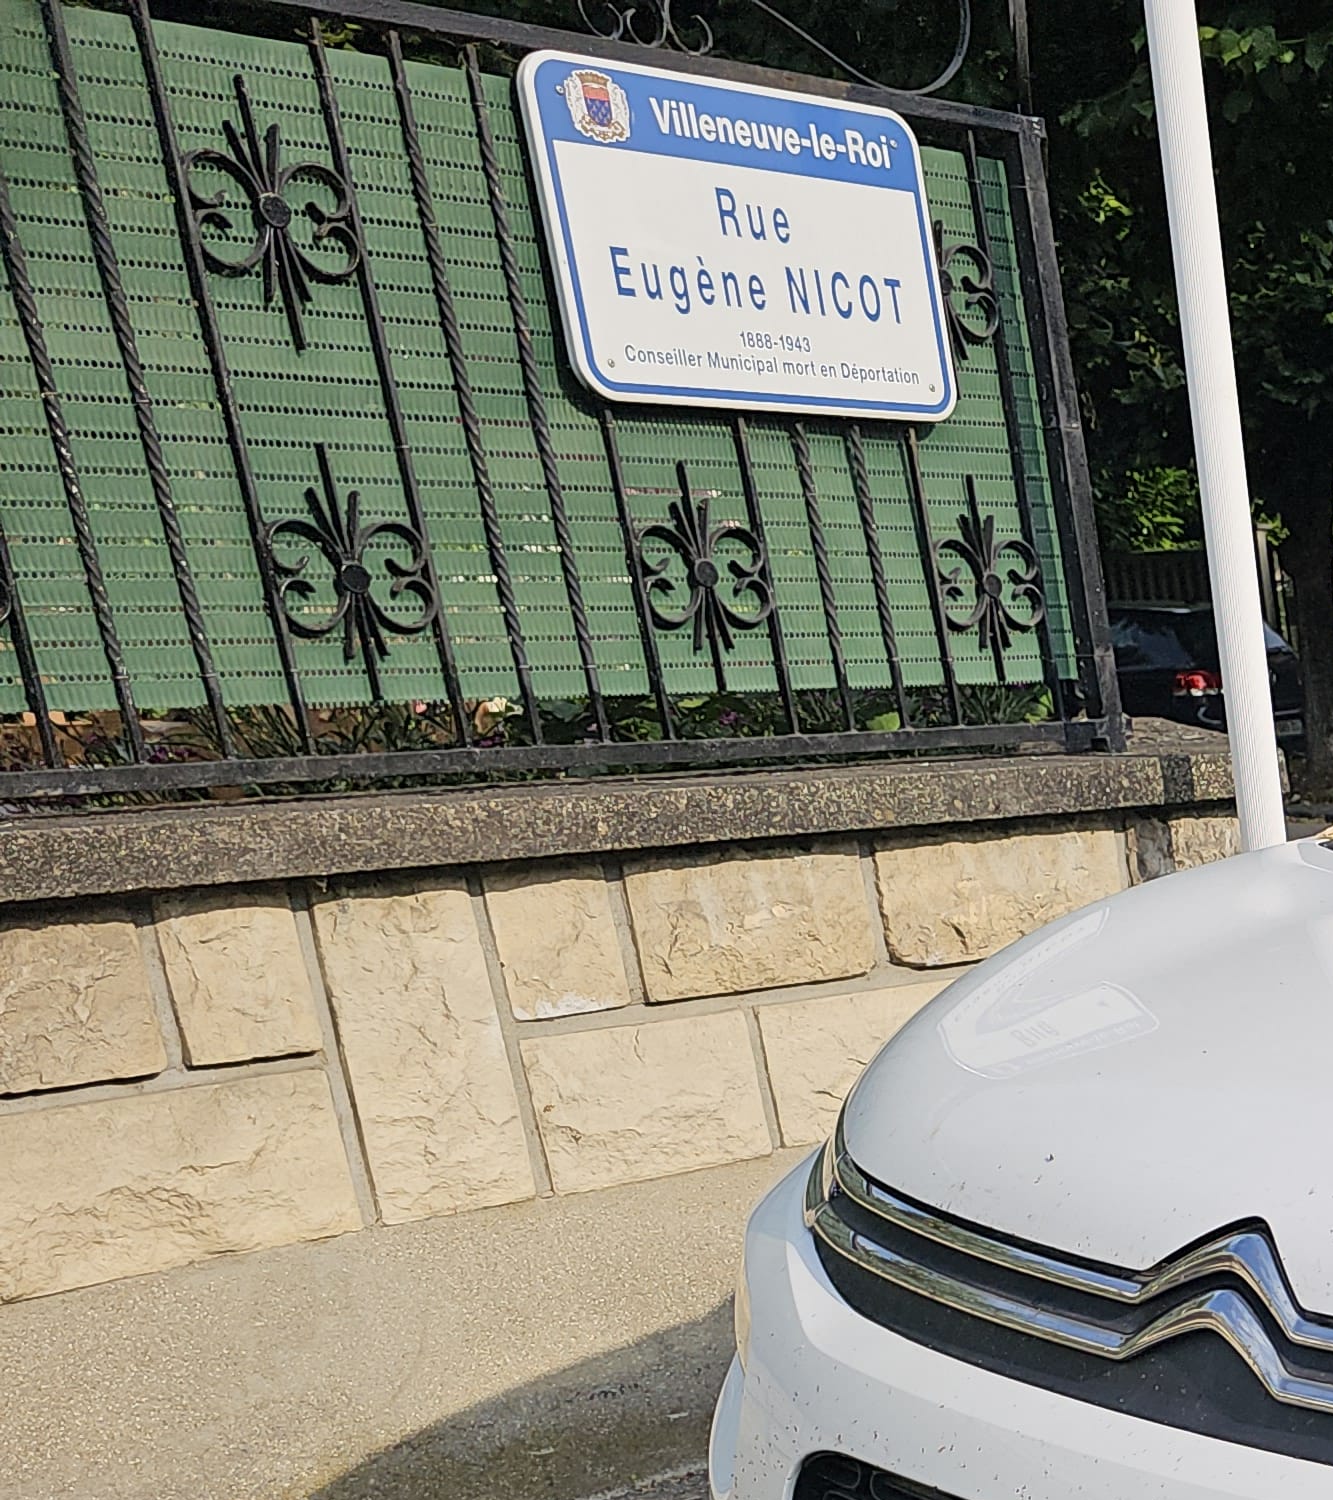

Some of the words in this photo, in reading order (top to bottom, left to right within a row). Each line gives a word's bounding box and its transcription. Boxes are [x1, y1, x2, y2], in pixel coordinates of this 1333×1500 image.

[649, 96, 892, 169] Villeneuve-le-Roi
[715, 187, 790, 243] Rue
[609, 246, 767, 314] Eugène
[785, 266, 902, 324] NICOT
[625, 344, 702, 368] Conseiller
[707, 351, 778, 375] Municipal
[783, 359, 817, 377] mort
[820, 364, 838, 379] en
[841, 363, 920, 385] Déportation
[739, 331, 811, 352] 1888-1943
